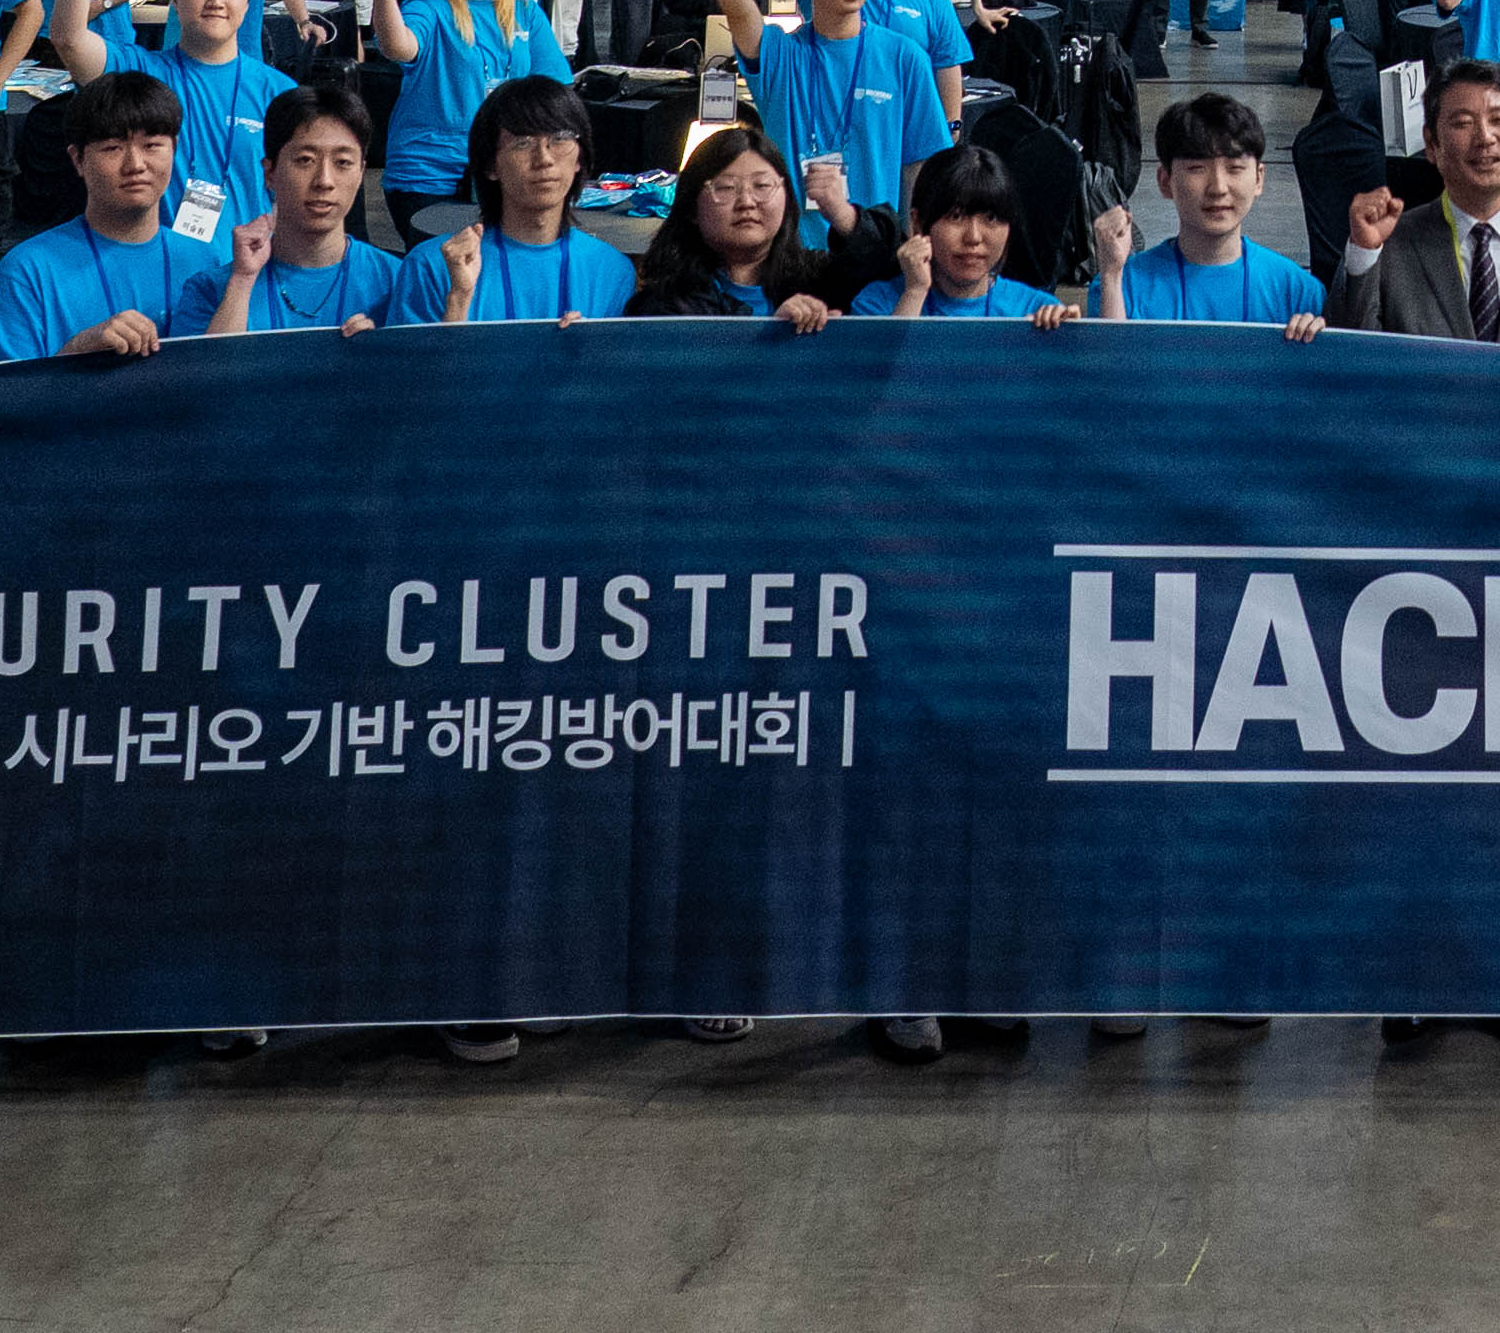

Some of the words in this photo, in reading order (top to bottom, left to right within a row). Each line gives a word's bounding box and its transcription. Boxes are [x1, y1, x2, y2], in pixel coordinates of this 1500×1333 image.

[386, 573, 868, 667] CLUSTER
[5, 705, 266, 785] 시나리오
[282, 701, 414, 778] 기반
[426, 690, 811, 773] 해킹방어대회
